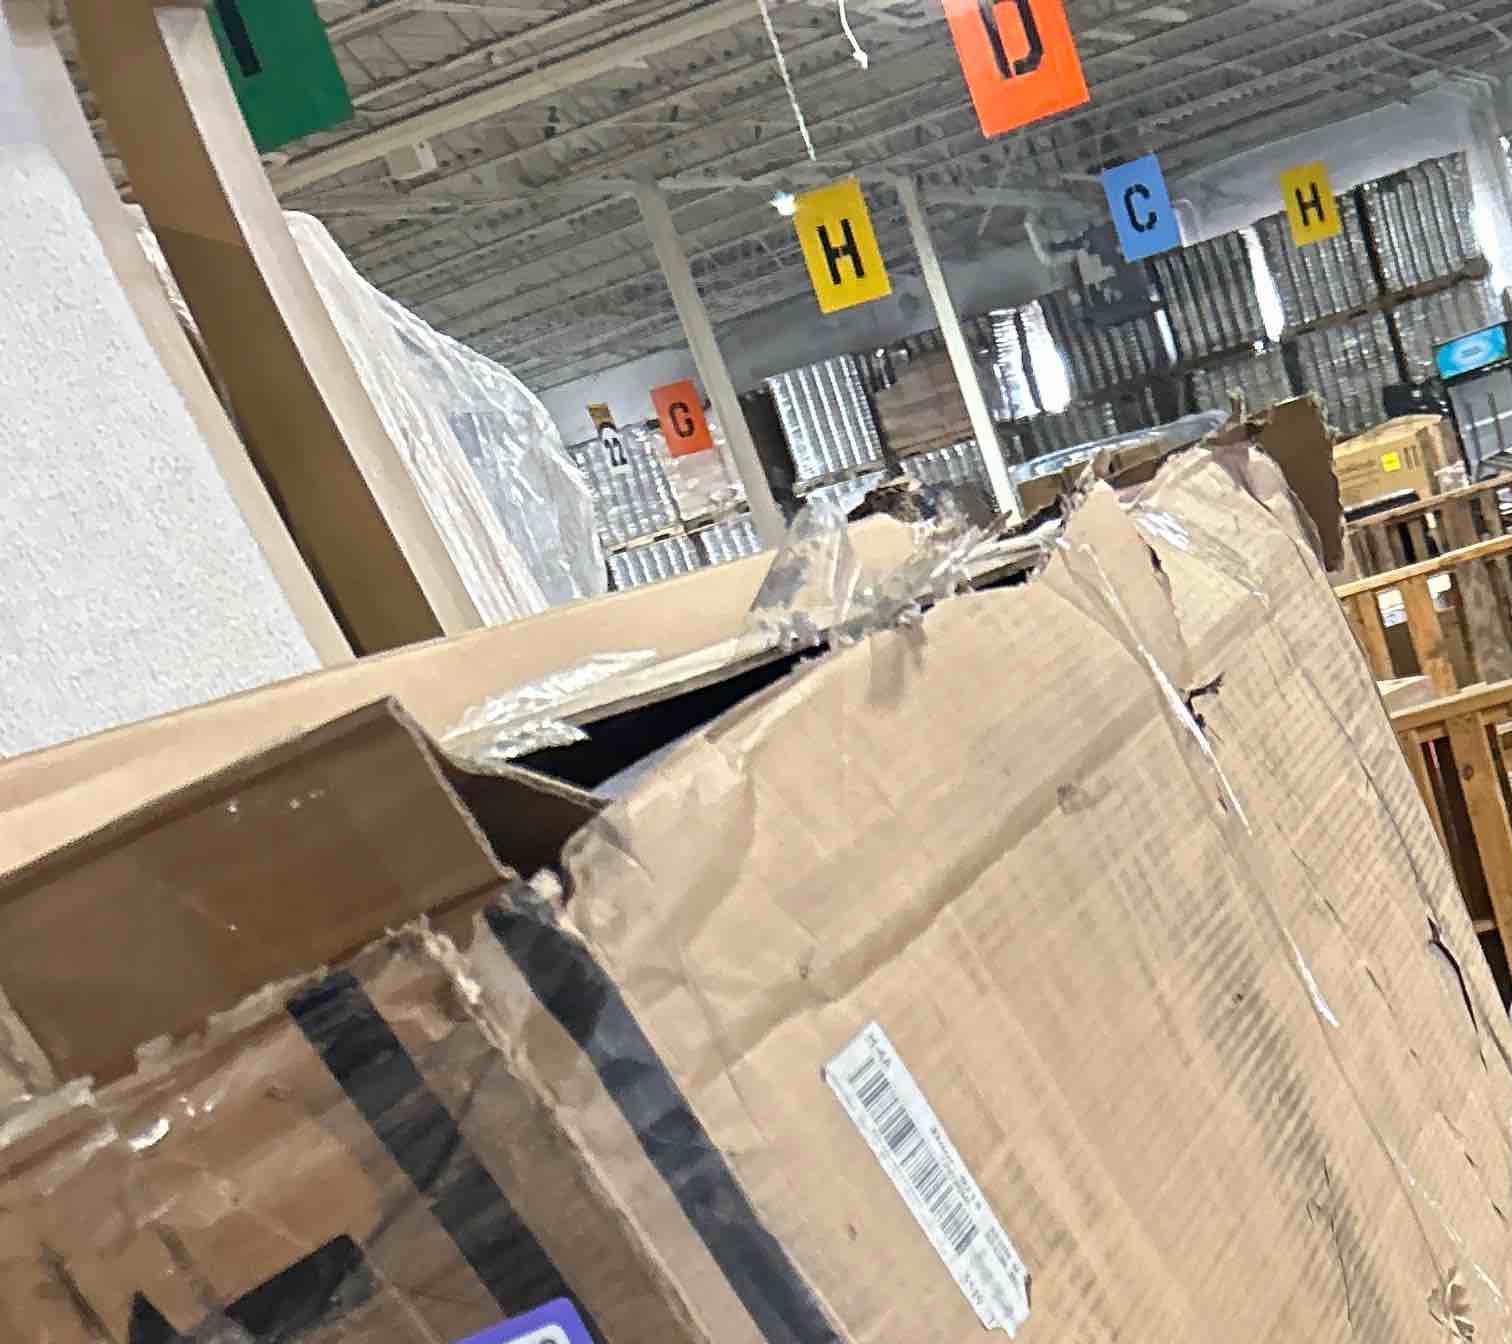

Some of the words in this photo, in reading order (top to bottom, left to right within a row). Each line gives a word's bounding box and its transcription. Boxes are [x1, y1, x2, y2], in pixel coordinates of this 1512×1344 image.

[978, 0, 1043, 79] D
[1123, 184, 1159, 233] C
[1295, 182, 1324, 227] H
[817, 219, 868, 285] H
[669, 401, 694, 438] G
